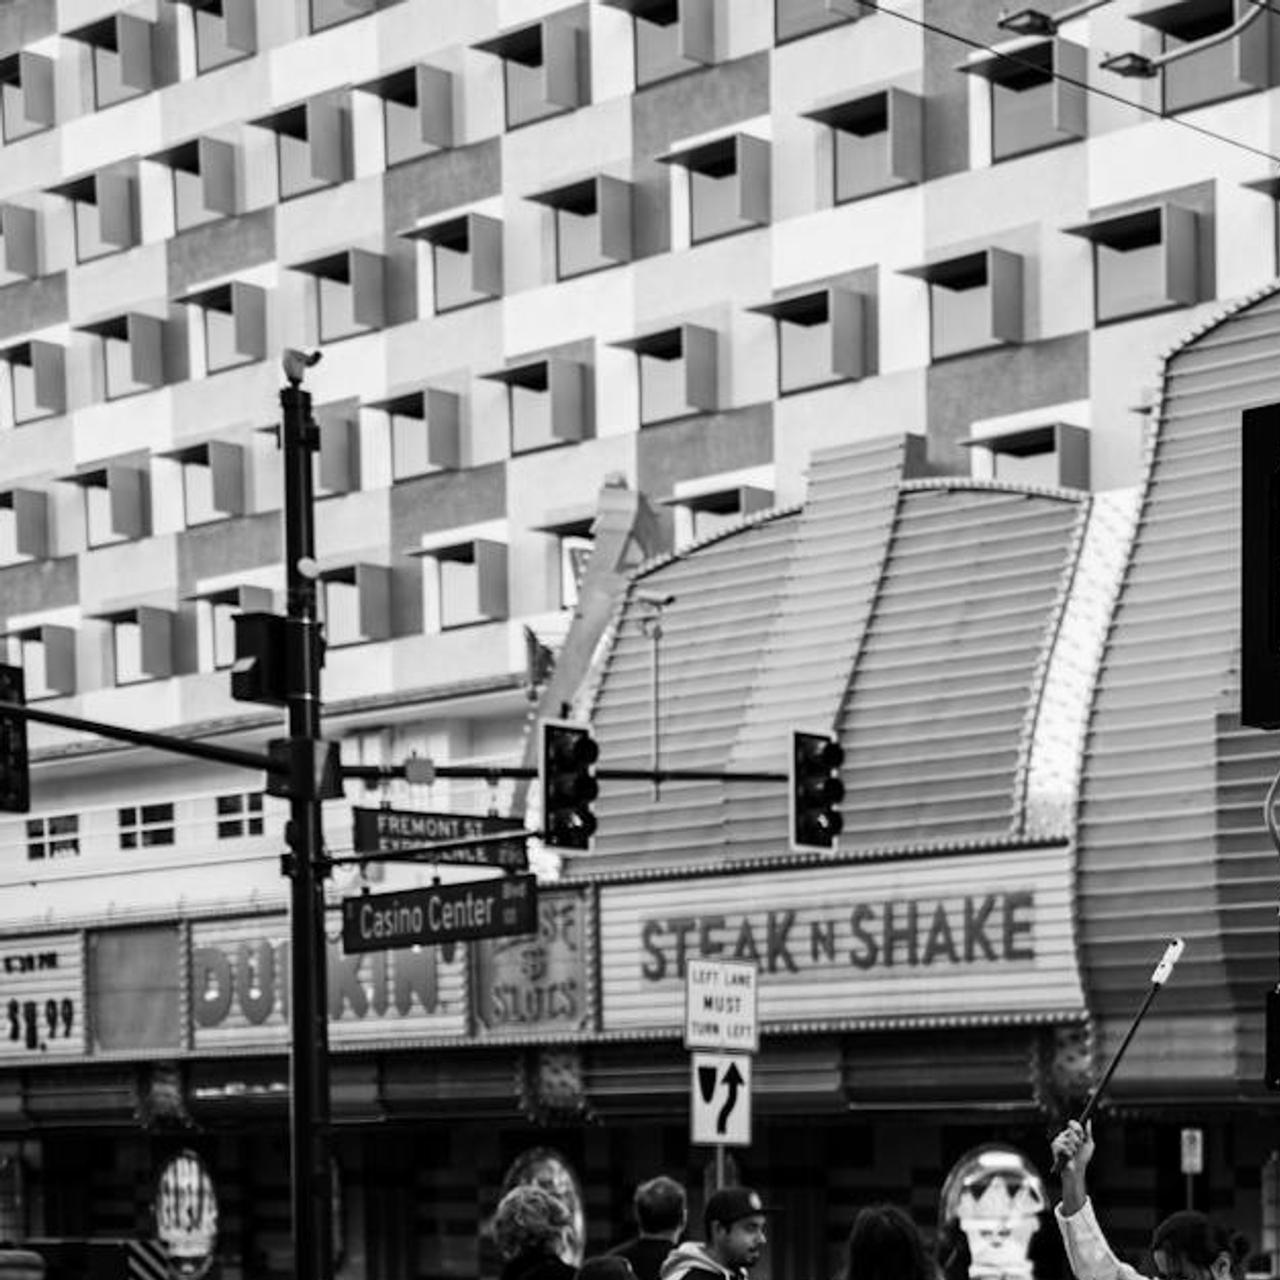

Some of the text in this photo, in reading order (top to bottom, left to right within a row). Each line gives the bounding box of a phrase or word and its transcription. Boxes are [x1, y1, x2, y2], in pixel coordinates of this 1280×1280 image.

[377, 814, 460, 838] FREMONT
[361, 902, 423, 939] Casino
[429, 894, 494, 932] Center
[641, 911, 798, 980] STEAK
[810, 920, 834, 962] N
[849, 891, 1034, 970] SHAKE
[703, 996, 741, 1013] MUST
